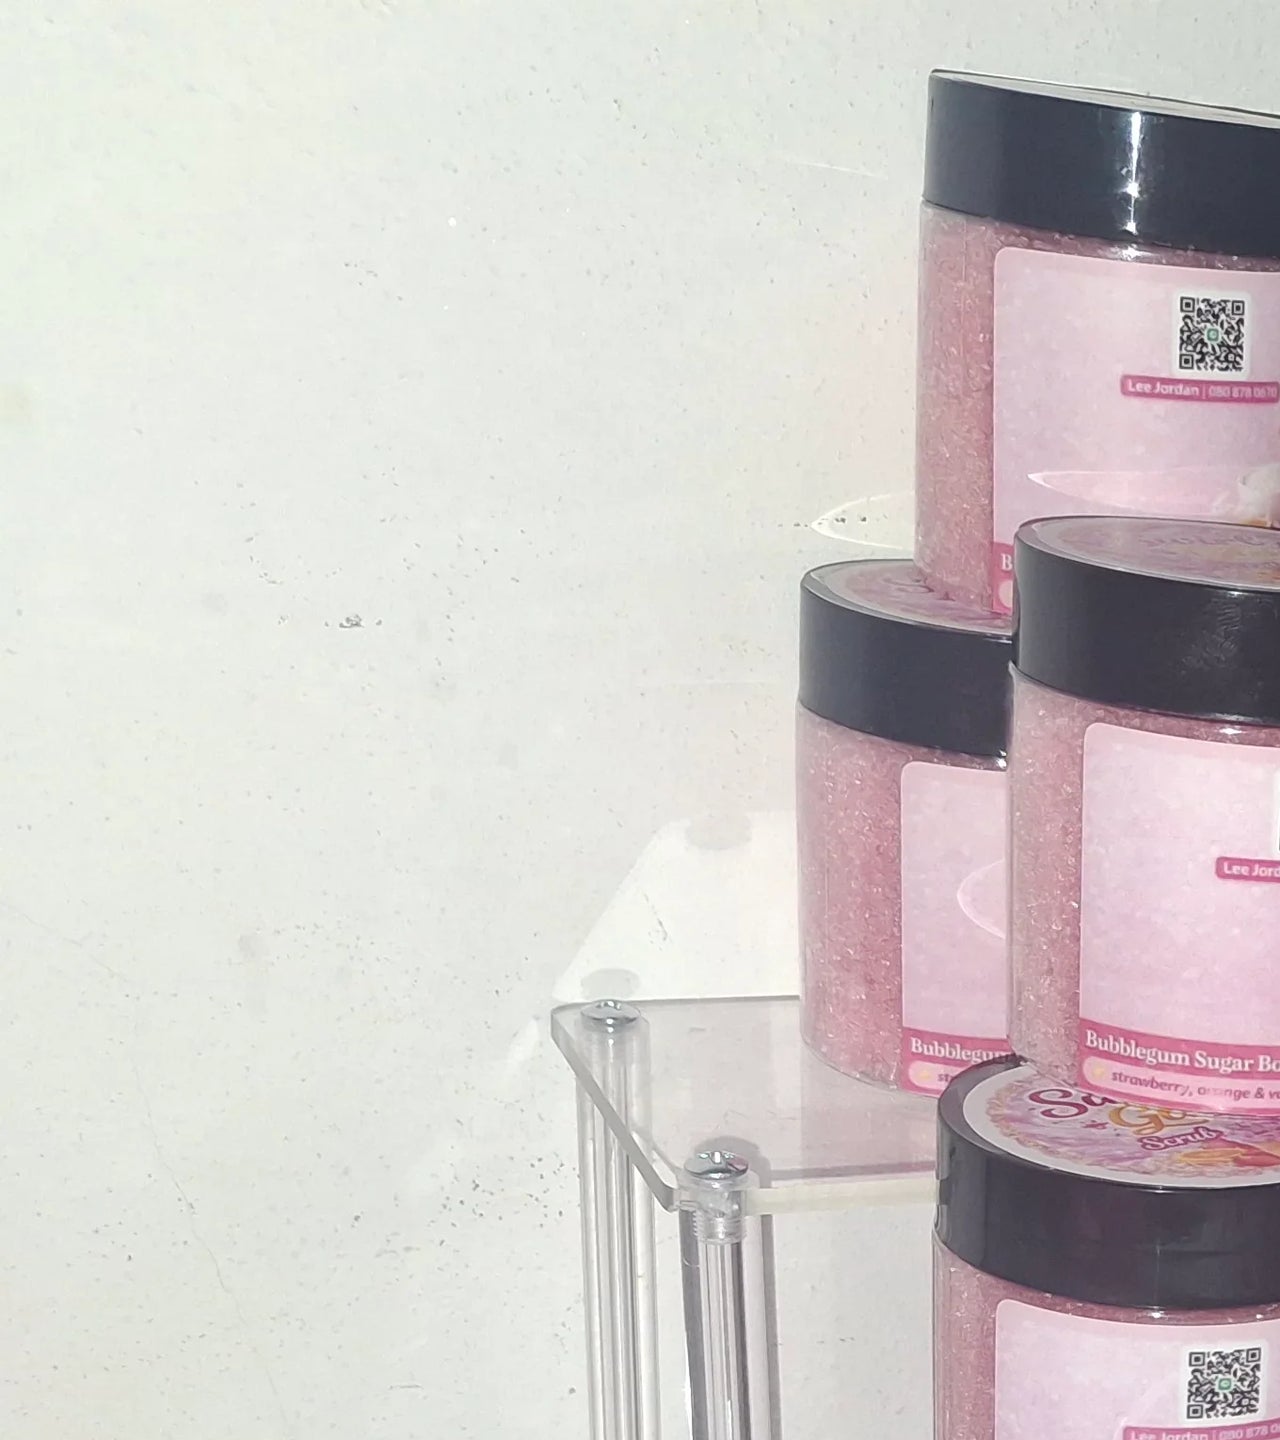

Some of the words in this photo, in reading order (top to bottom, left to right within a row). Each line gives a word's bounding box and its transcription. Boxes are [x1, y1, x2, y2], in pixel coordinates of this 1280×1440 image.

[1128, 378, 1152, 393] Lee
[1153, 380, 1199, 398] Jordan
[1223, 863, 1249, 877] Lee
[1085, 1029, 1190, 1067] Bubblegum
[1194, 1051, 1255, 1075] Sugar
[1111, 1070, 1194, 1097] strawberry,
[1254, 1087, 1264, 1099] &
[1139, 1126, 1224, 1152] Scrub
[1244, 1425, 1268, 1439] 878
